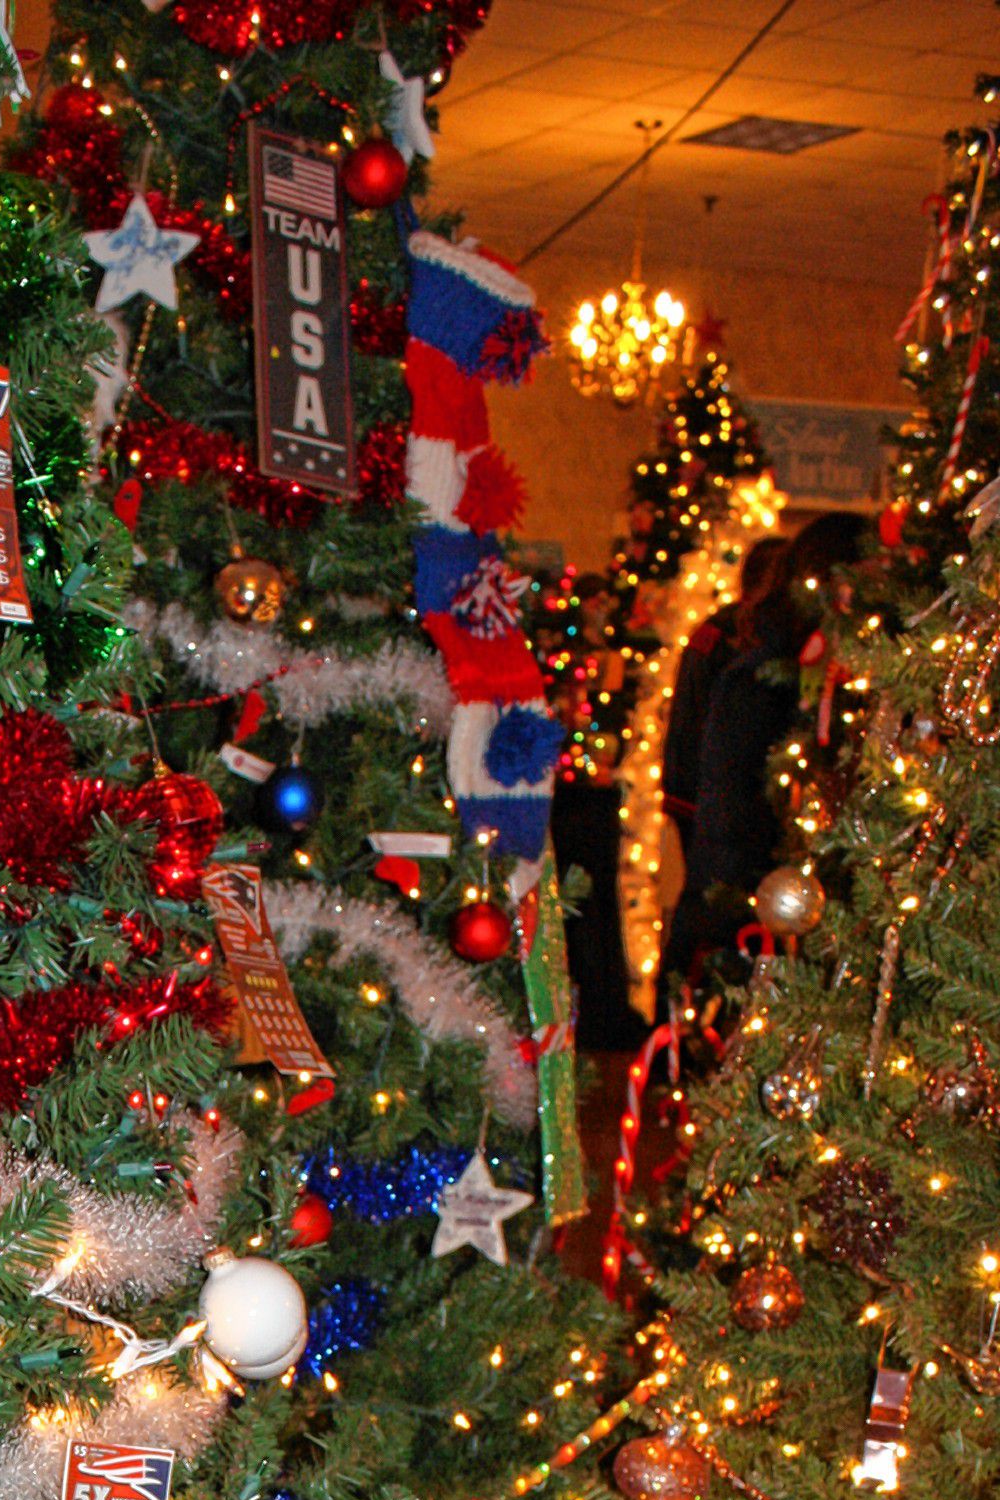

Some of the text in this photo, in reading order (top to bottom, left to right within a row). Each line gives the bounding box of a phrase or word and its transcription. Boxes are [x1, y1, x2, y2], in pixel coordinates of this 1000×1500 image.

[262, 205, 341, 251] TEAM
[287, 243, 329, 438] USA
[73, 1445, 88, 1457] $5
